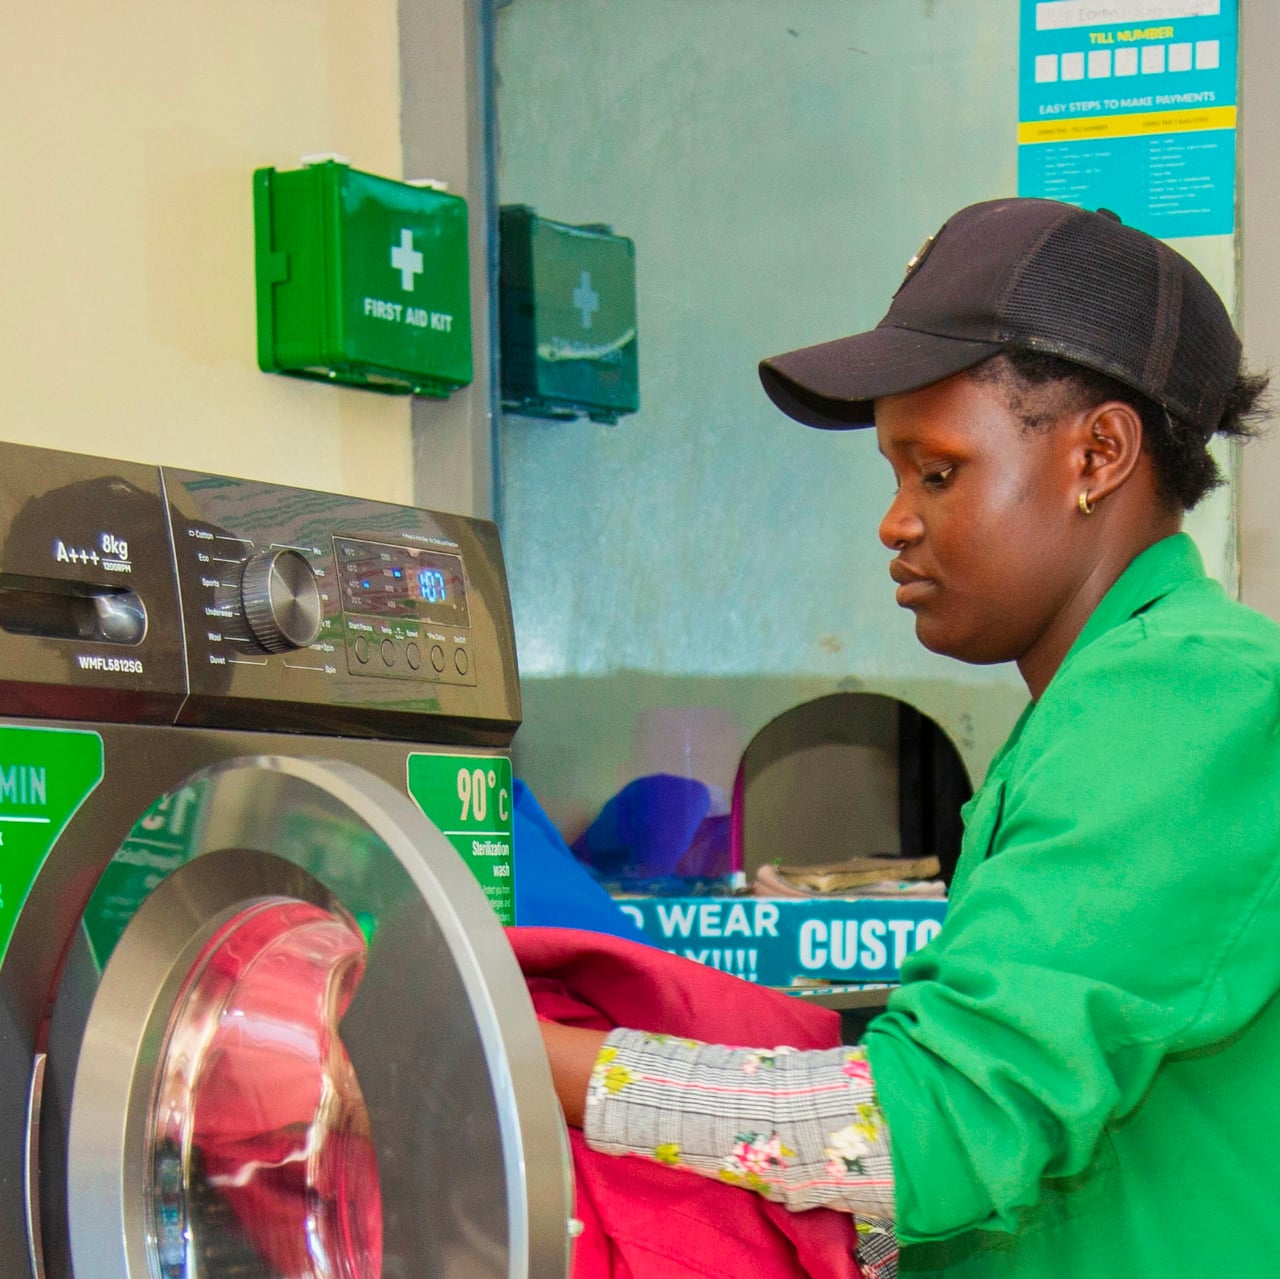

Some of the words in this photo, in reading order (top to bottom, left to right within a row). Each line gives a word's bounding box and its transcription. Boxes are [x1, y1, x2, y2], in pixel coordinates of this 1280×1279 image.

[1089, 32, 1114, 44] TILL
[1117, 26, 1174, 42] NUMBER
[1039, 103, 1066, 115] EASY
[1069, 101, 1101, 112] STEPS
[1104, 99, 1119, 109] TO
[1121, 96, 1153, 108] MAKE
[1155, 91, 1216, 105] PAYMENTS
[364, 297, 402, 323] FIRST
[405, 306, 428, 328] AID
[431, 312, 453, 332] KIT
[56, 540, 100, 566] A+++
[101, 533, 129, 560] 8kg
[78, 655, 144, 674] WMFL5812SG
[471, 840, 510, 857] Sterilization
[492, 862, 510, 877] wash
[656, 903, 780, 939] WEAR
